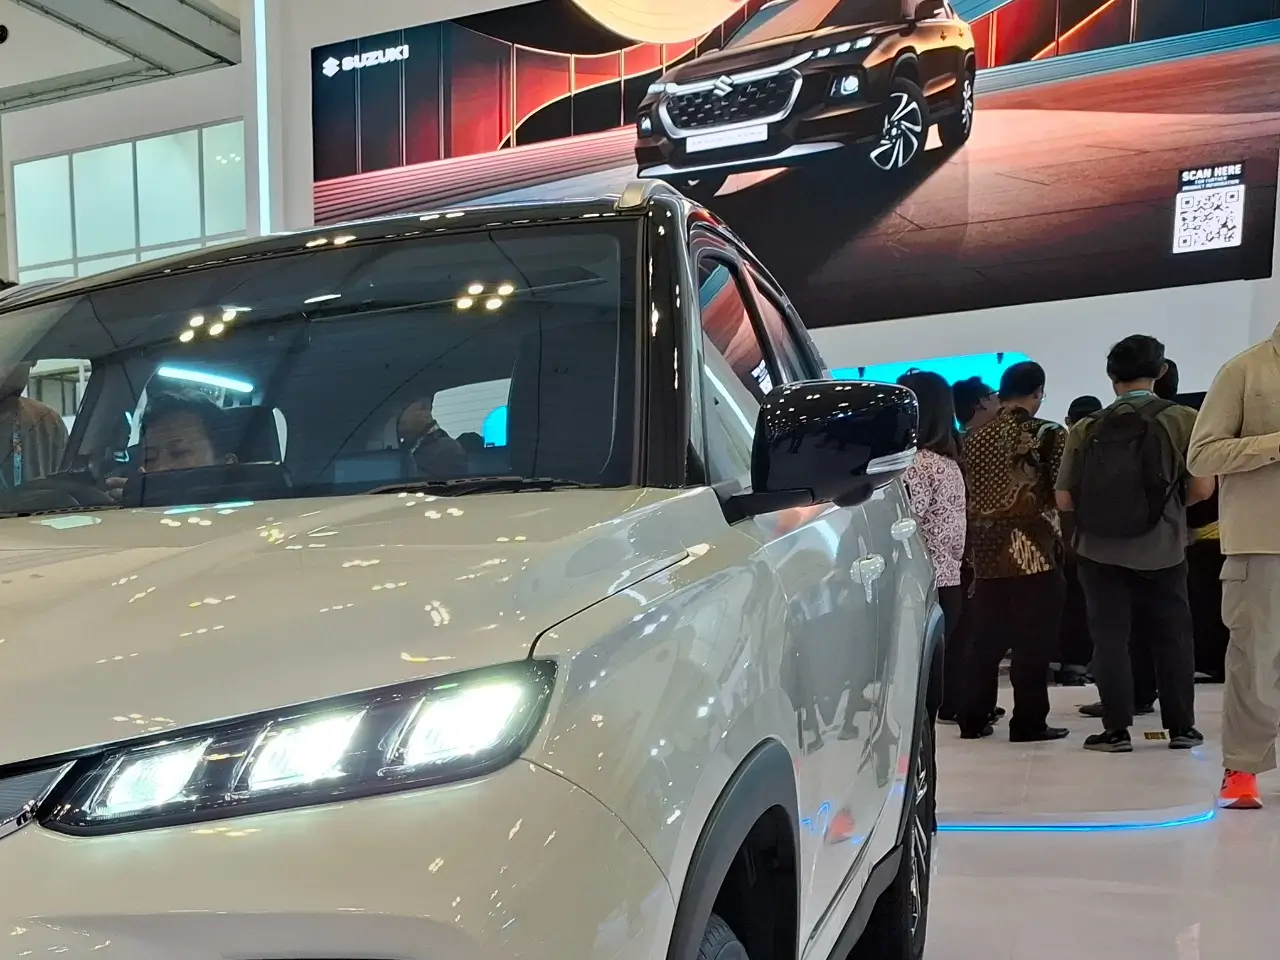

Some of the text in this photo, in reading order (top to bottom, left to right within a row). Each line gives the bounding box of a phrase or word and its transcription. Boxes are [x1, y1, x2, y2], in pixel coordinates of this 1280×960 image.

[341, 44, 410, 71] SUZUKI
[1182, 164, 1242, 181] SCAN HERE
